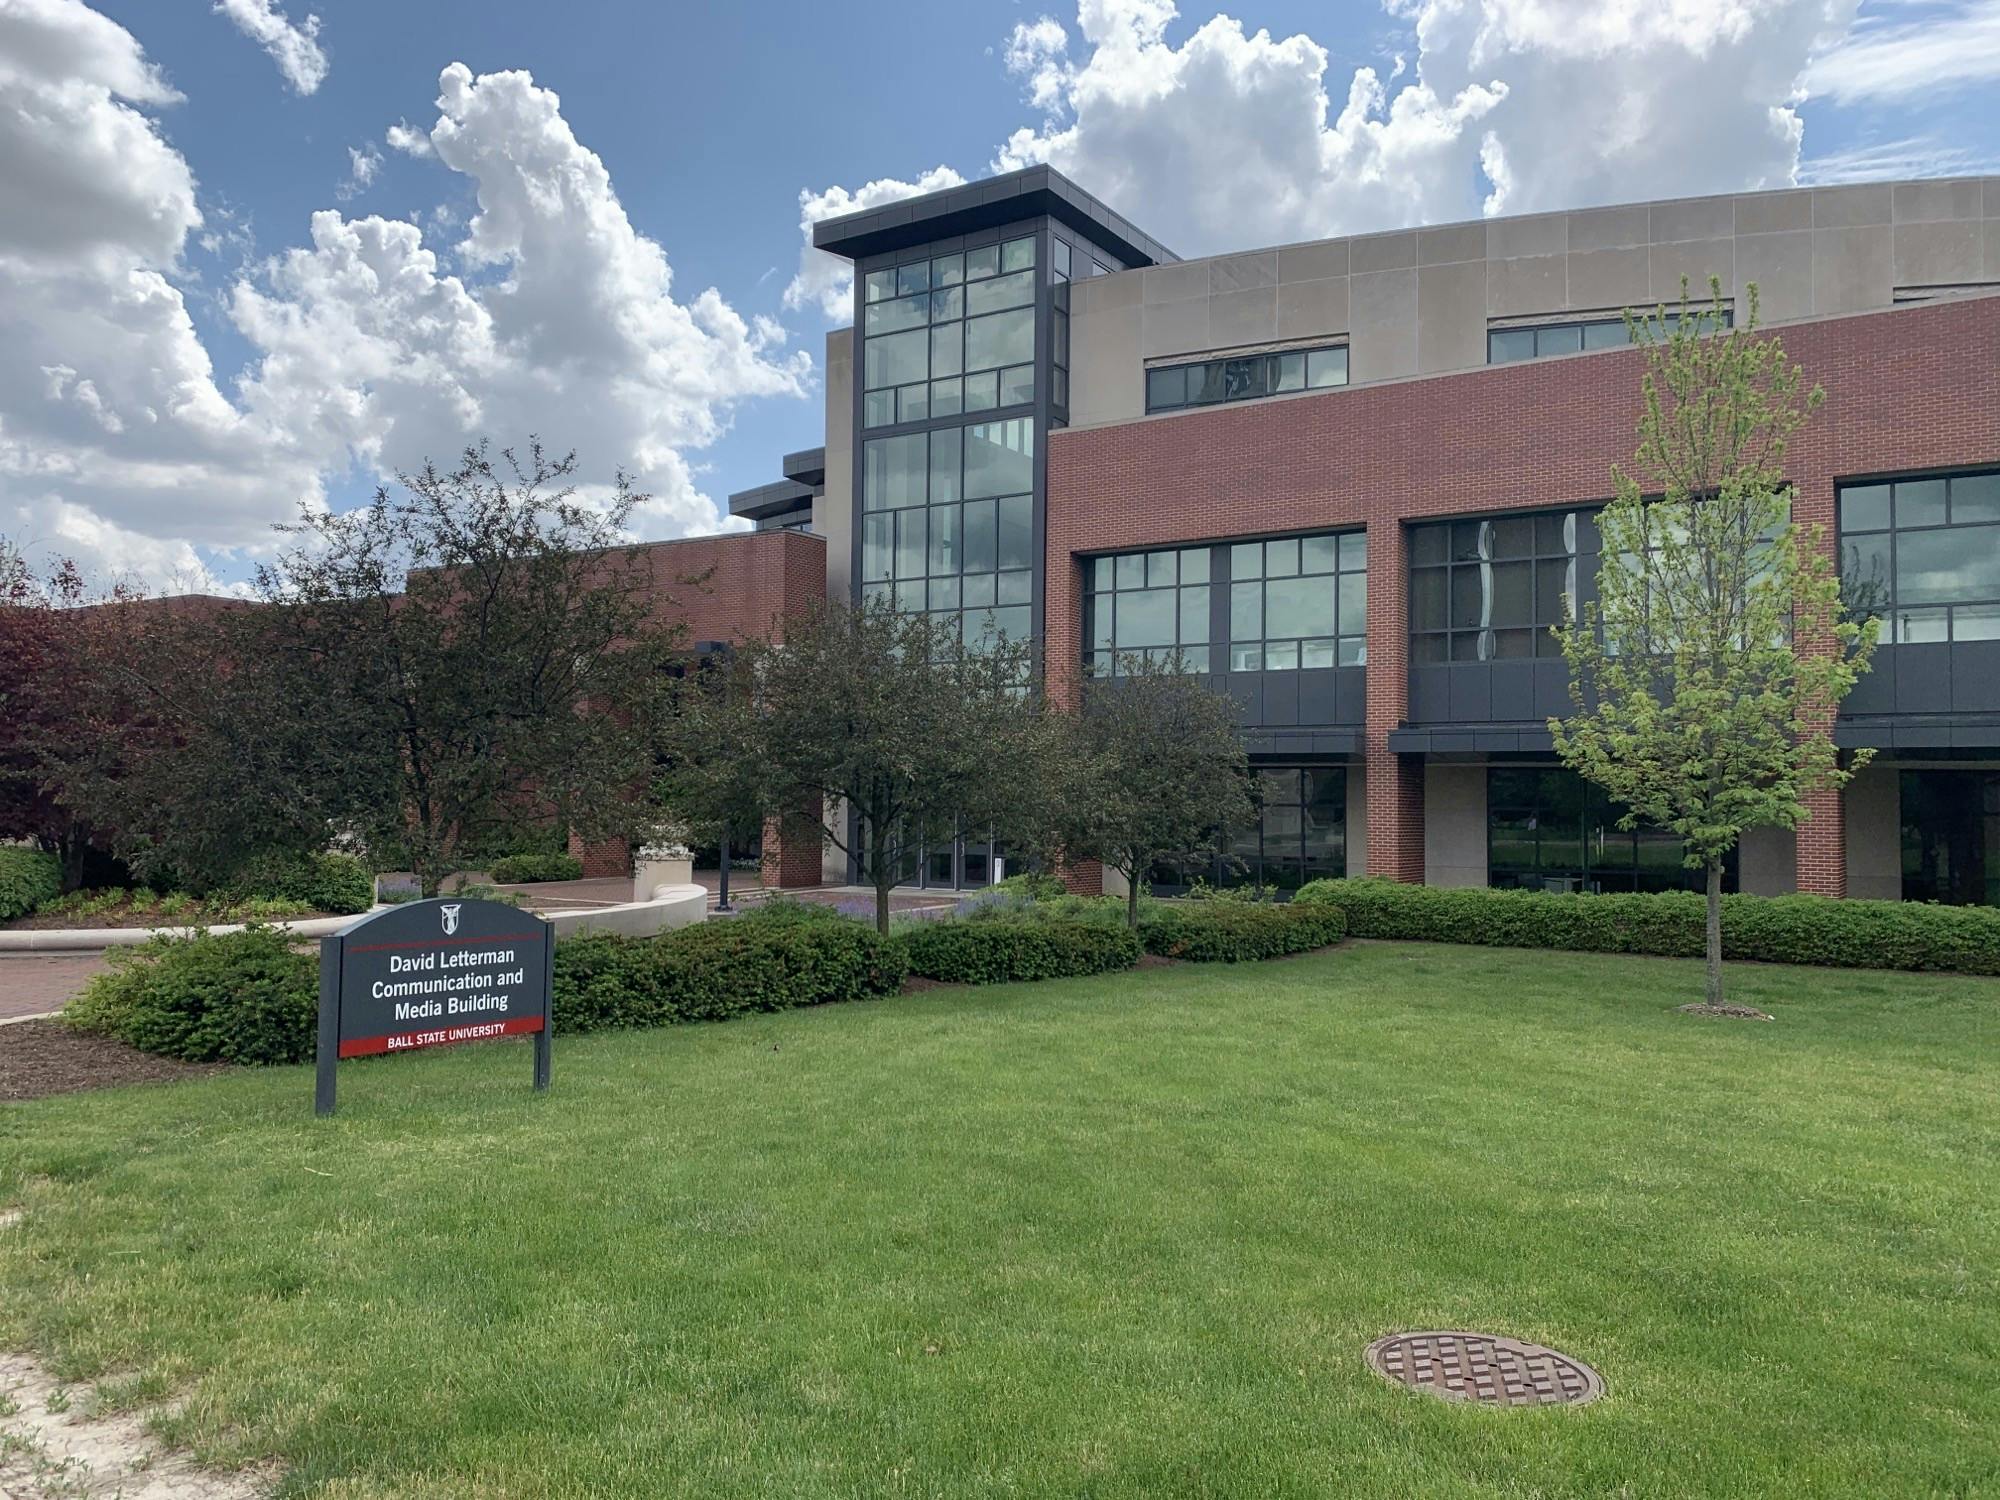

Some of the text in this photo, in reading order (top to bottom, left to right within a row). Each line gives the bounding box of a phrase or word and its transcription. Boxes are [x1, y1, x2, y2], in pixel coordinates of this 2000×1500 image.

[390, 949, 515, 973] David Letterman
[372, 968, 523, 999] Communication and
[395, 993, 509, 1021] Media Building
[387, 1023, 506, 1049] BALL STATE UNIVERSITY
